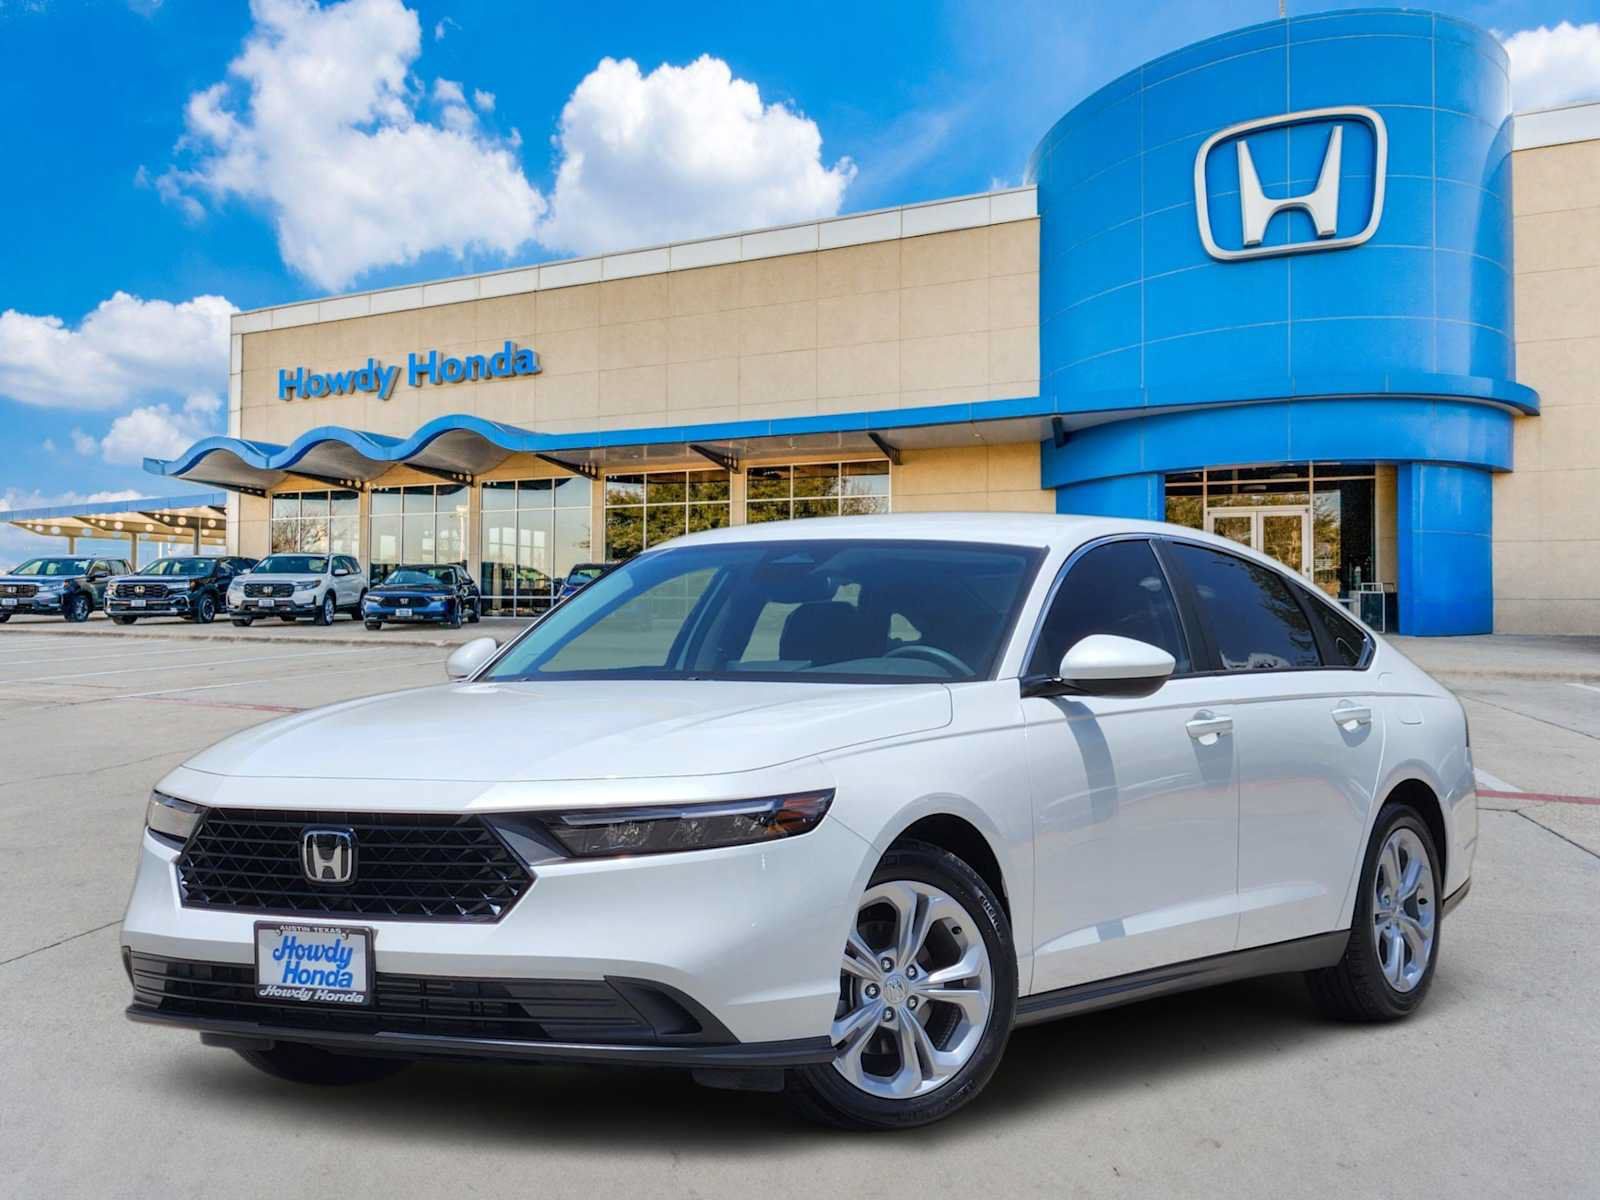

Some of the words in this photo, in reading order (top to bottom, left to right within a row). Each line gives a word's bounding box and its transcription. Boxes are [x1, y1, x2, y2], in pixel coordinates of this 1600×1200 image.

[277, 357, 401, 401] Howdy
[408, 340, 542, 387] Honda
[273, 935, 353, 969] Howdy
[282, 960, 353, 988] Honda
[260, 985, 312, 1001] Howdy
[314, 989, 364, 1003] Honda
